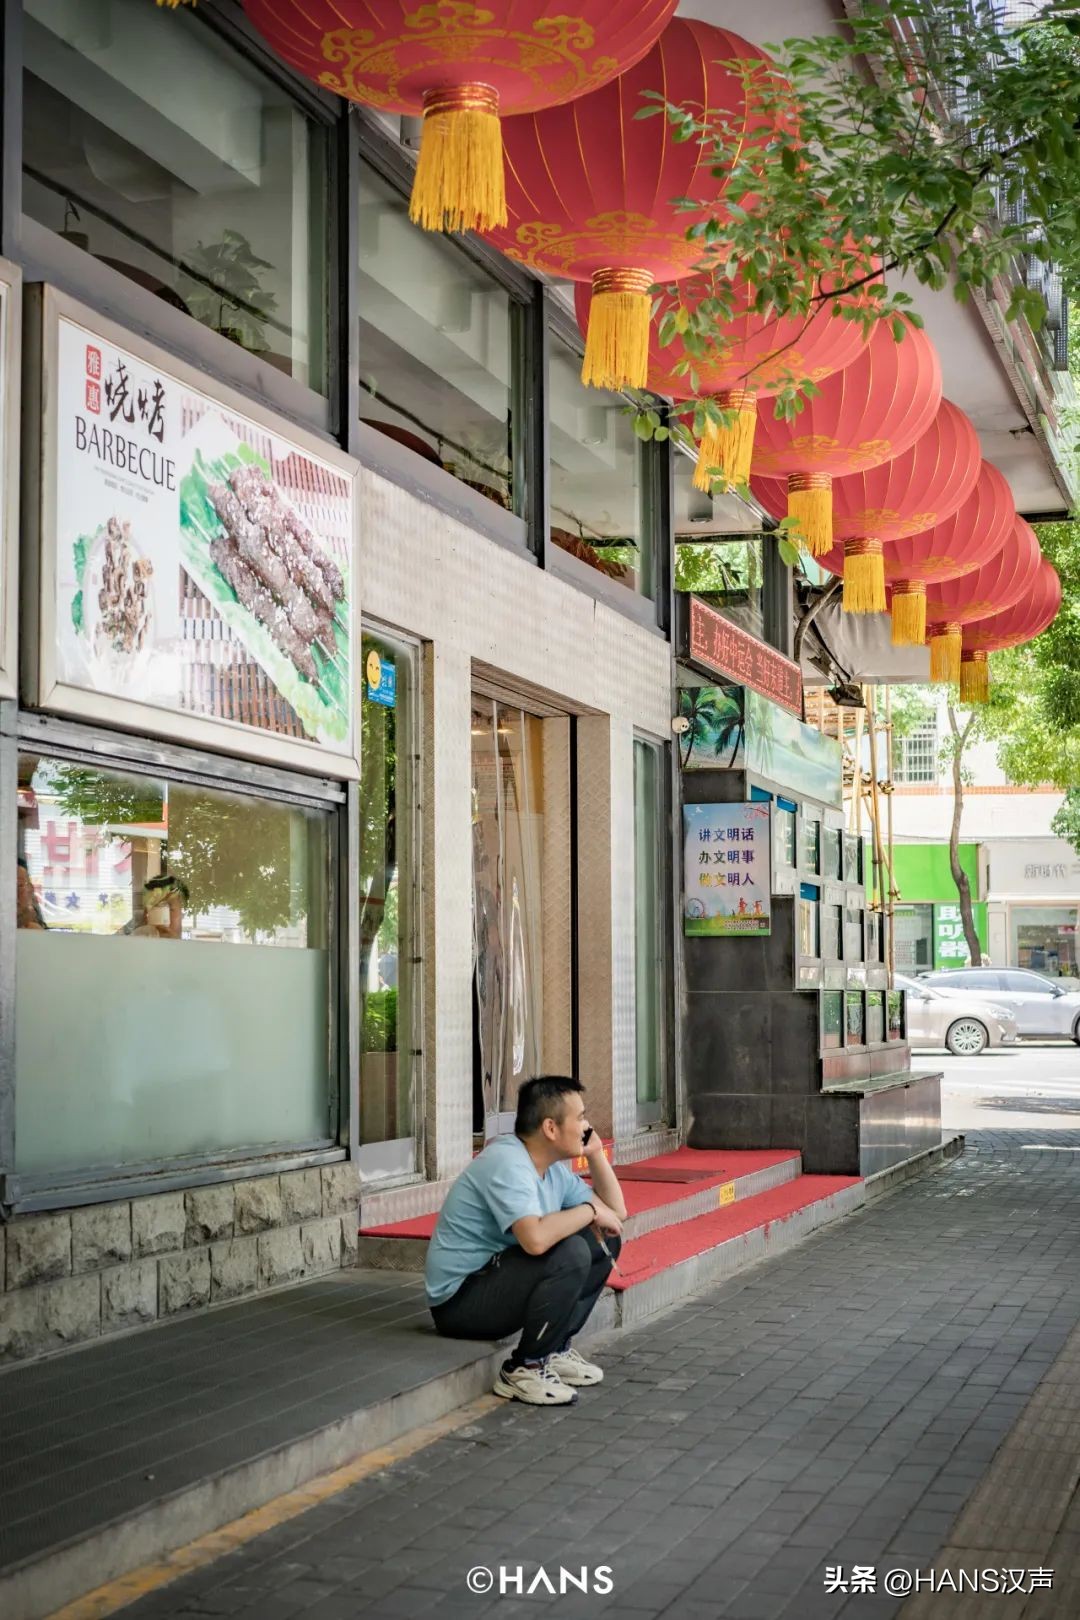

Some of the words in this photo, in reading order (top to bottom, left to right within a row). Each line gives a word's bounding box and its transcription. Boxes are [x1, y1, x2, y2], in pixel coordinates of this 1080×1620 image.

[104, 356, 165, 443] 烧烤
[75, 415, 176, 491] BARBECUE
[698, 827, 755, 842] 讲文明话
[698, 850, 755, 865] 办文明事
[698, 872, 755, 888] 做文明人
